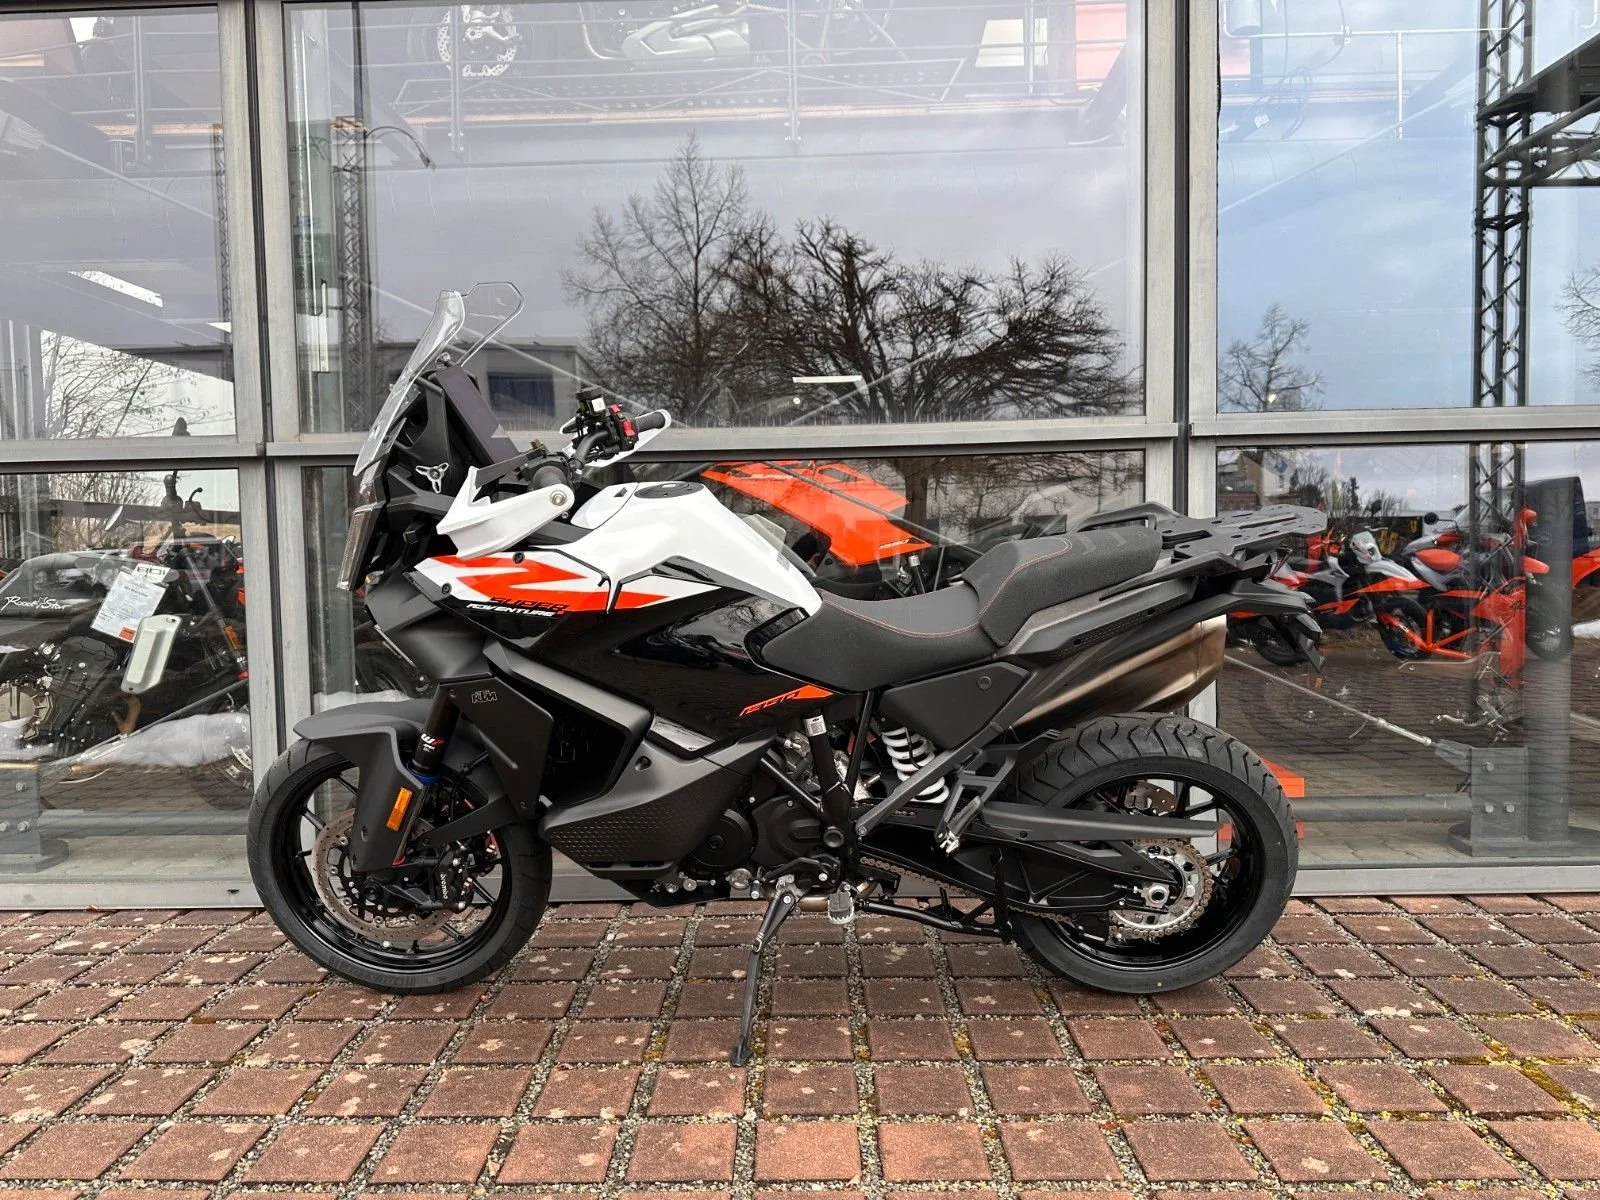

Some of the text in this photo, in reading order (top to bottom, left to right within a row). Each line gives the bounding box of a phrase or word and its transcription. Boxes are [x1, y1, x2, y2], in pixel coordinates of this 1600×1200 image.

[466, 603, 555, 617] ADVENTURE
[490, 597, 569, 612] SUPER
[471, 689, 498, 704] KTM
[440, 872, 449, 900] brembo
